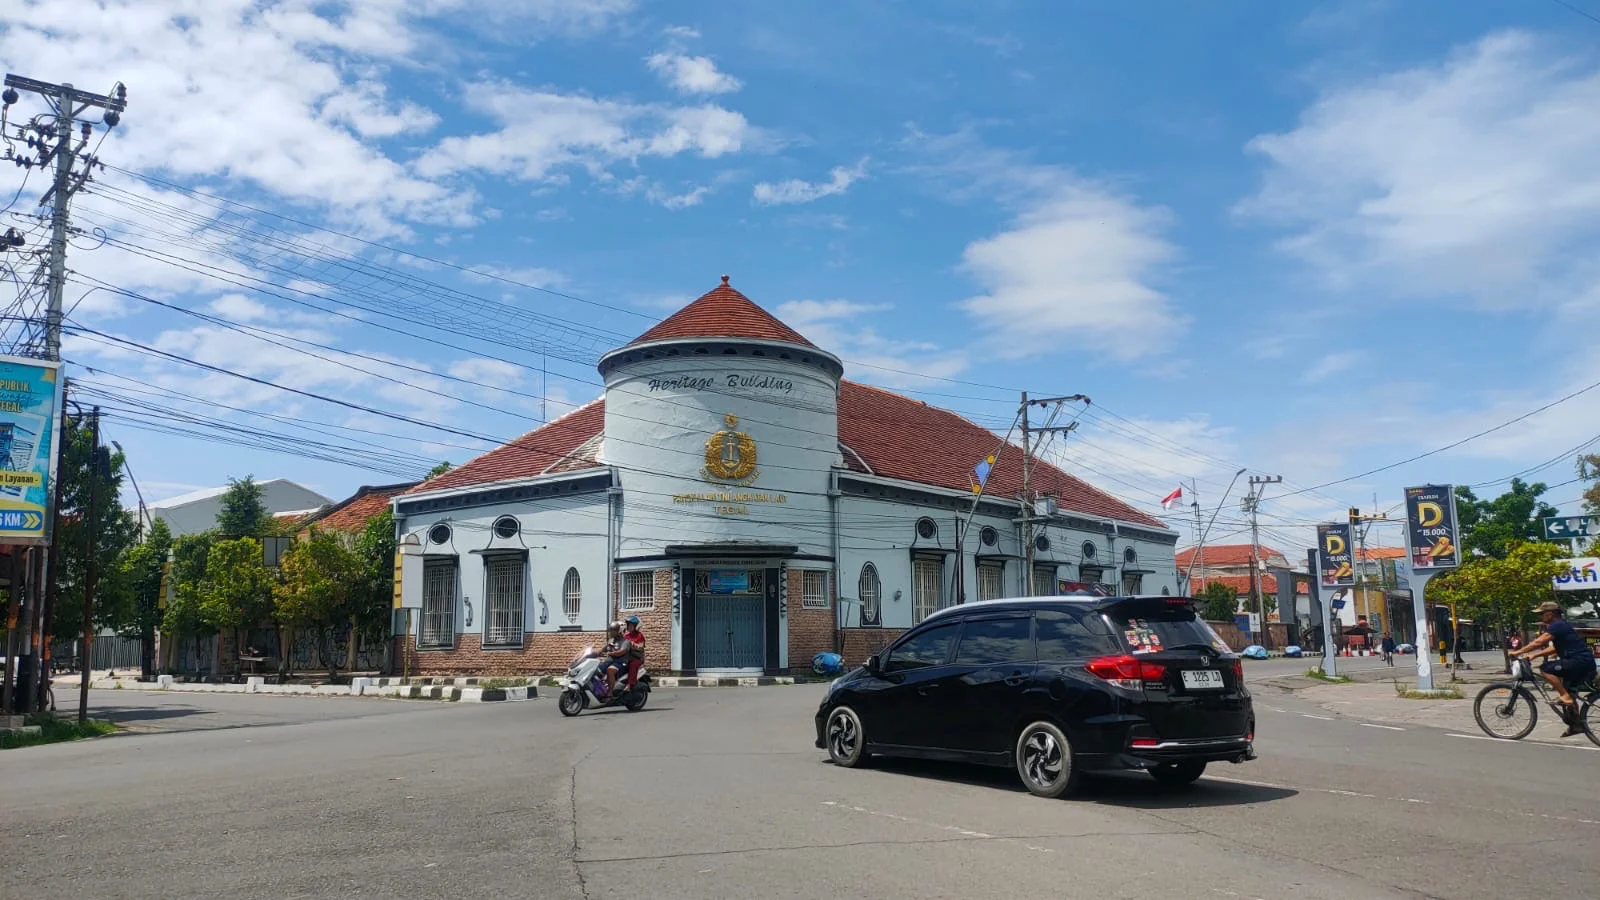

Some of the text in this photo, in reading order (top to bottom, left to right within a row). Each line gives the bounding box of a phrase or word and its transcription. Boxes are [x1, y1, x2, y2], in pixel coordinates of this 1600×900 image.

[648, 374, 793, 393] Heritage Building
[5, 473, 33, 485] Layanan
[4, 512, 20, 527] KM
[1418, 502, 1442, 527] D
[1326, 536, 1345, 555] D
[1183, 671, 1189, 682] E
